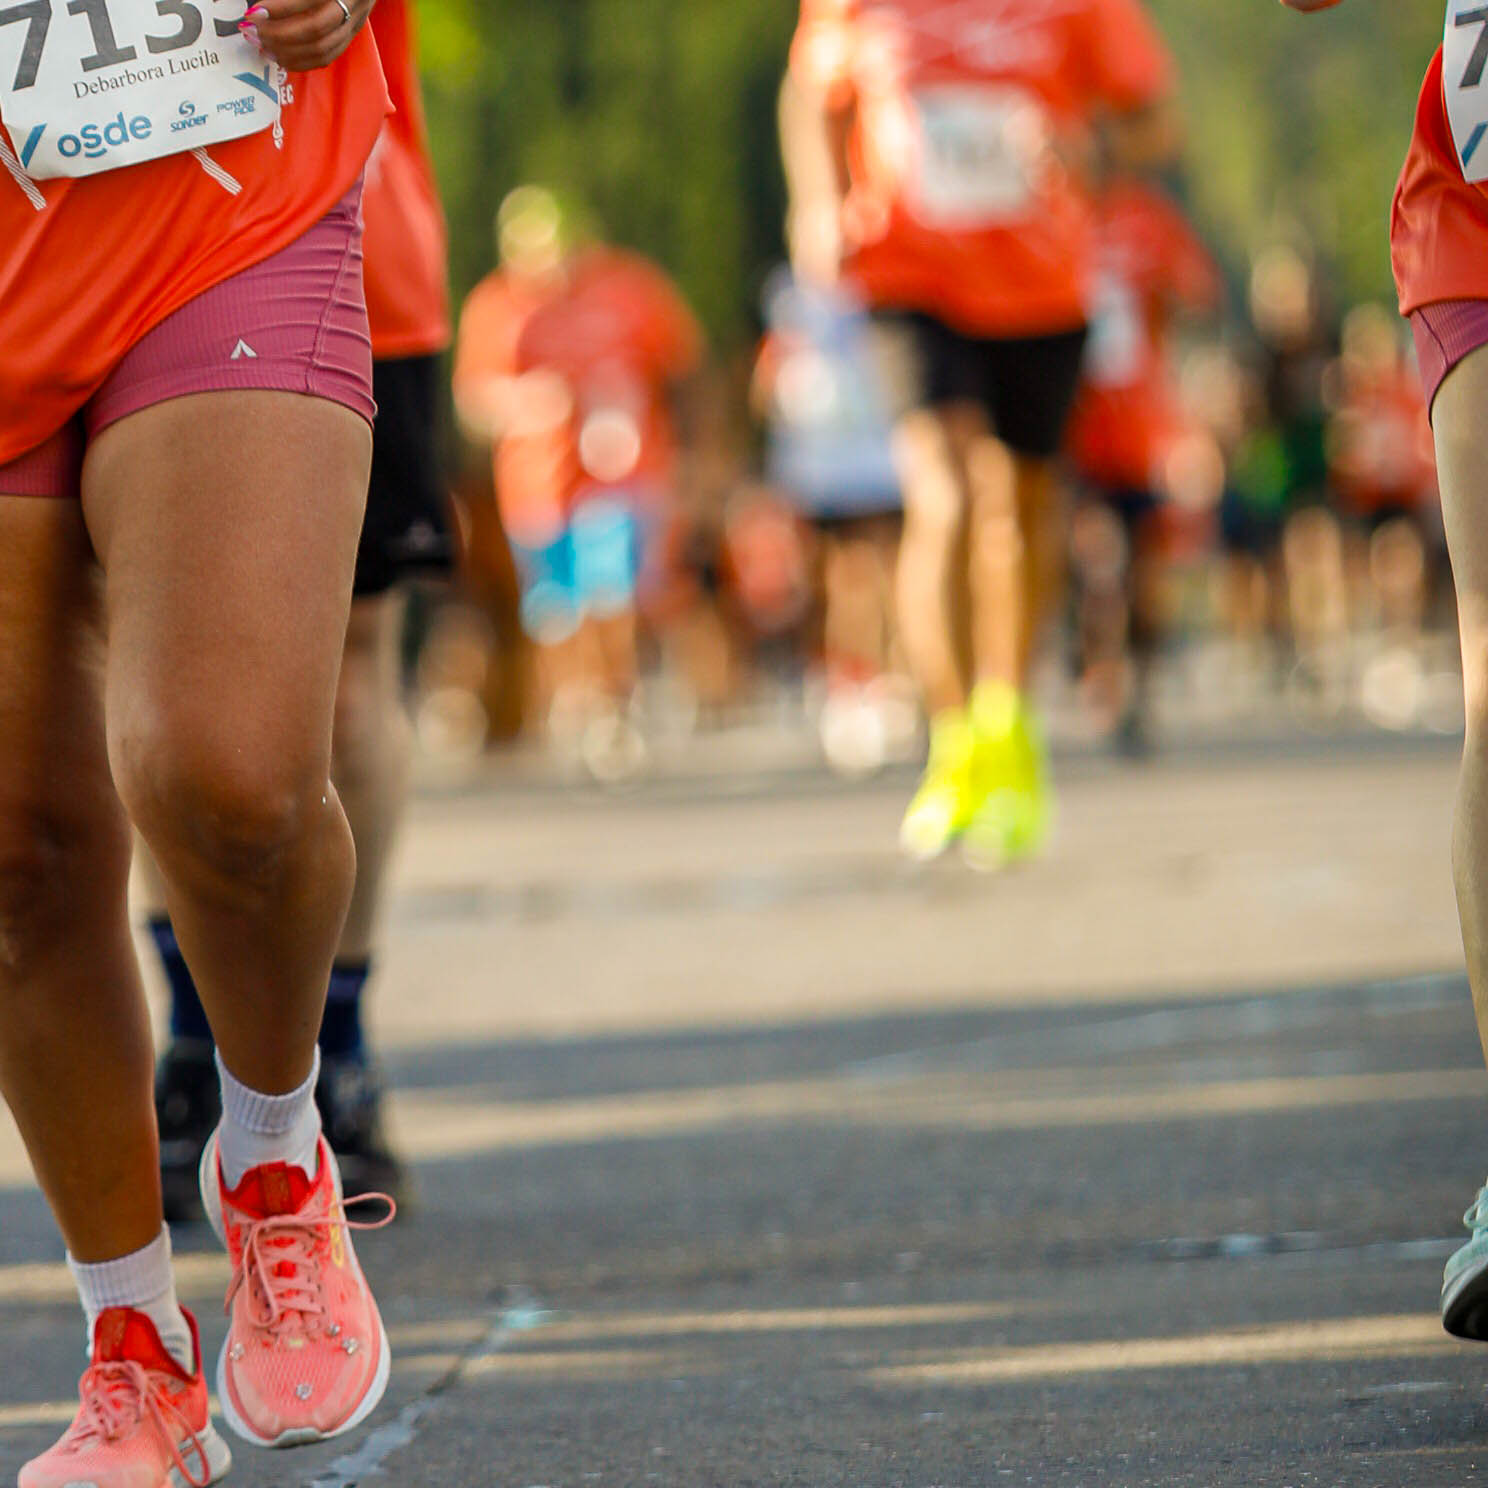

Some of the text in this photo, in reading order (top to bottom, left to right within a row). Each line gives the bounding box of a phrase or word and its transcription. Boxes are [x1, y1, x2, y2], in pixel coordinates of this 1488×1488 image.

[73, 49, 220, 100] Debarbora Lucila
[216, 95, 255, 113] POWER
[57, 111, 152, 158] osde
